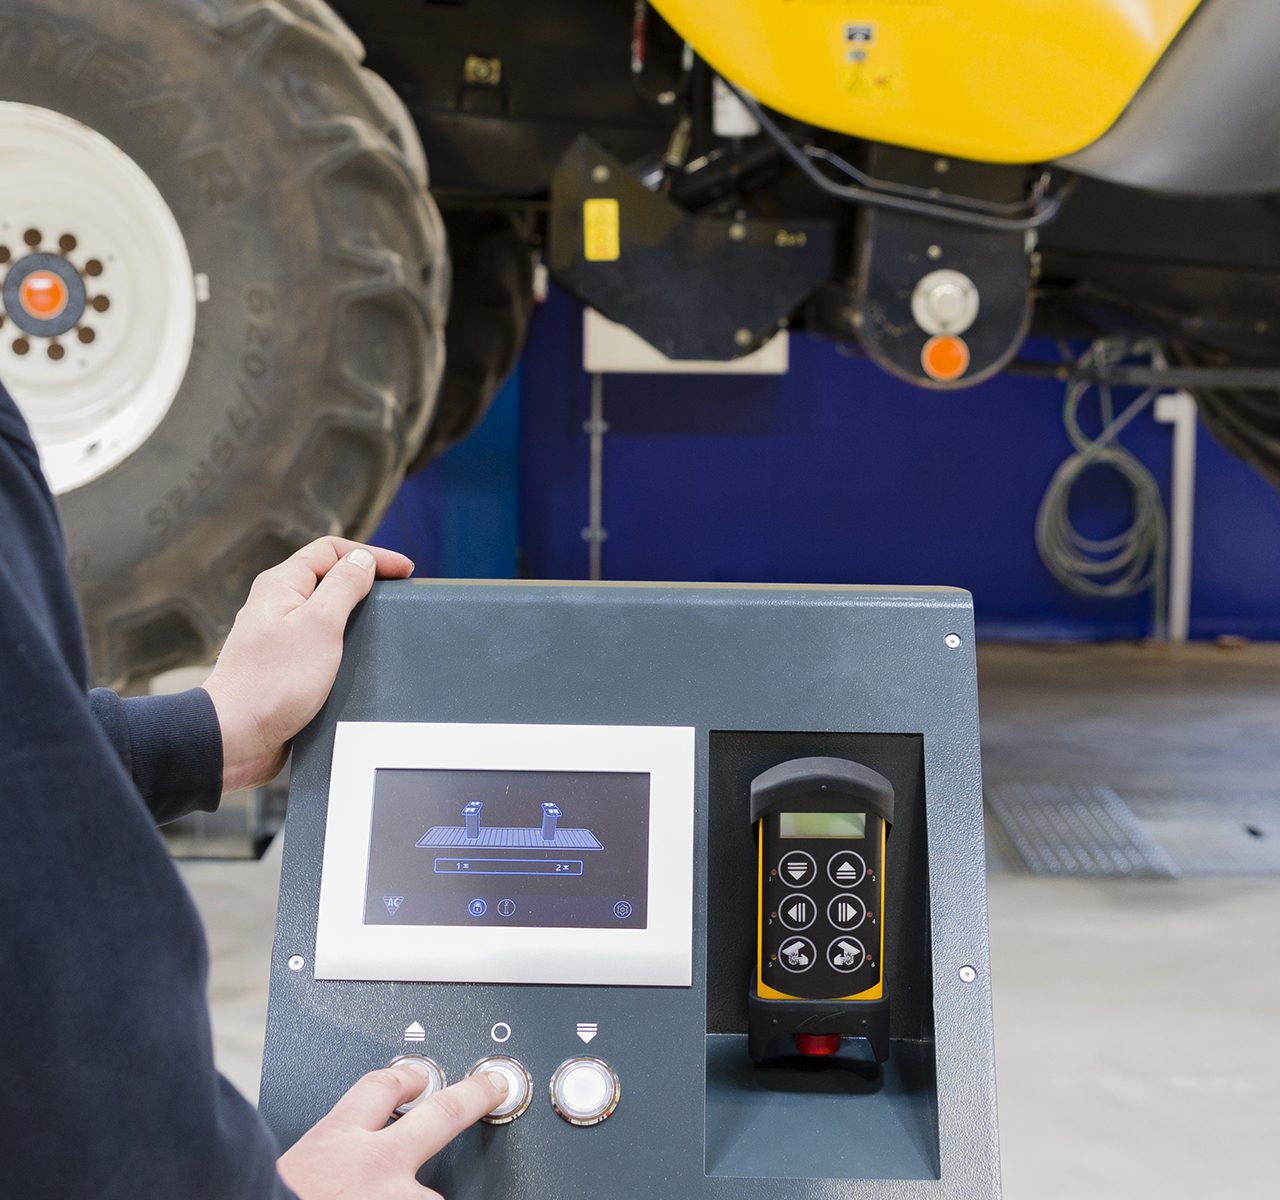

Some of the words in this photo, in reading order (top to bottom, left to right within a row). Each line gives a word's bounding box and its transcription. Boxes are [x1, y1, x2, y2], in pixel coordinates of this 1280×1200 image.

[456, 862, 461, 870] 1
[555, 863, 562, 872] 2
[387, 897, 401, 906] AC
